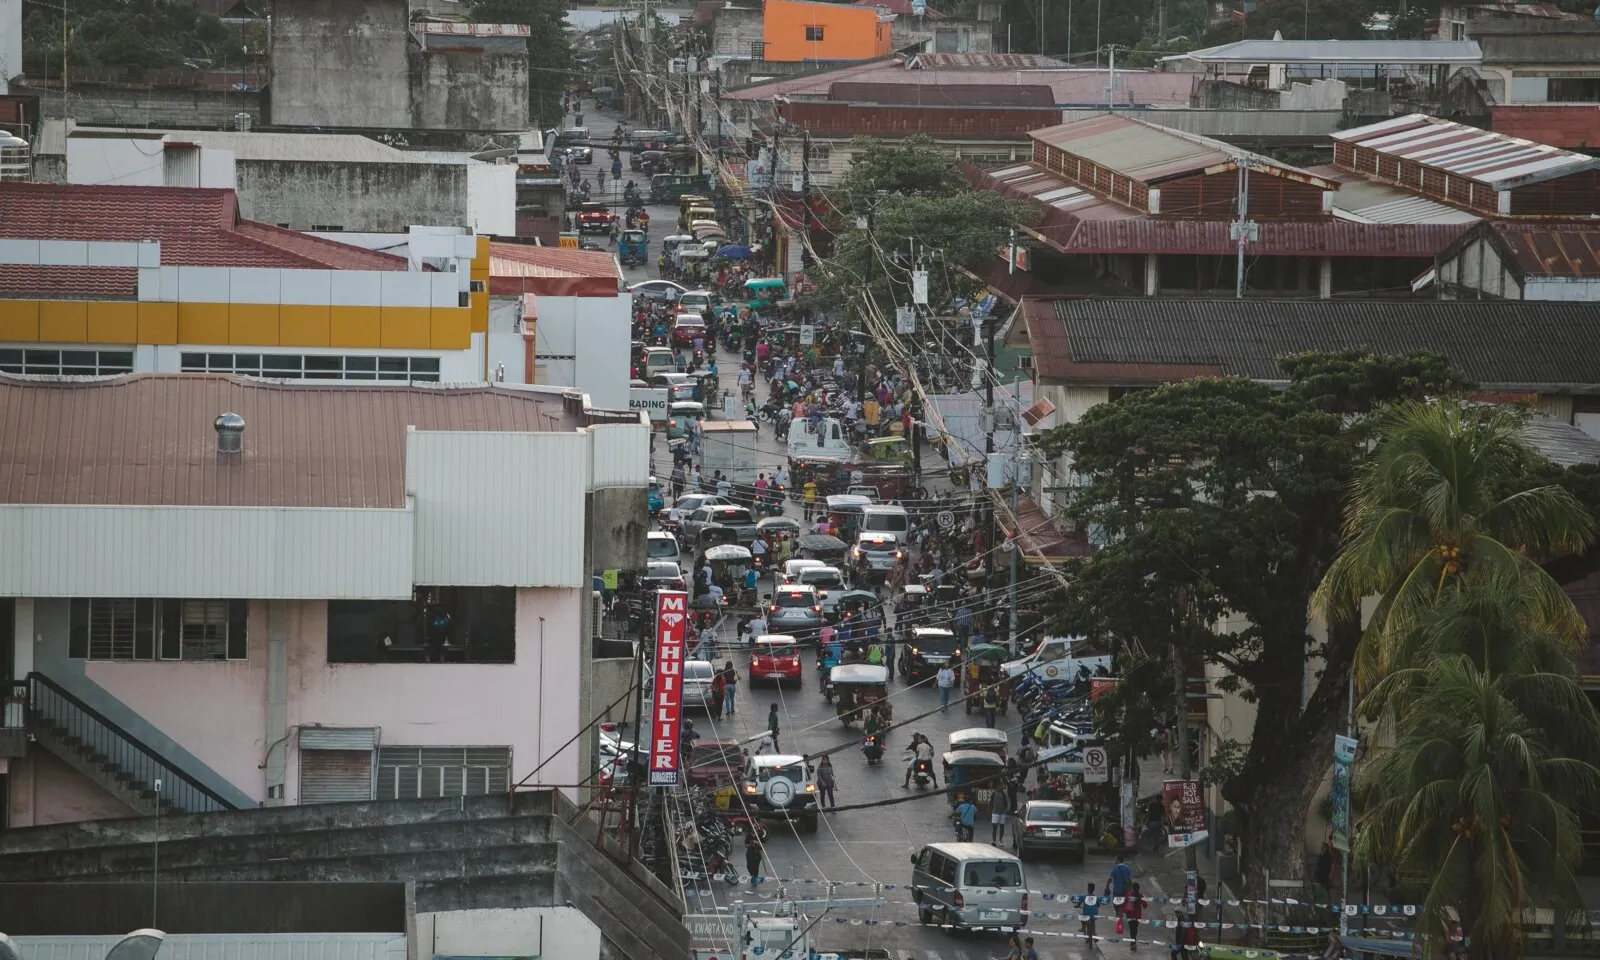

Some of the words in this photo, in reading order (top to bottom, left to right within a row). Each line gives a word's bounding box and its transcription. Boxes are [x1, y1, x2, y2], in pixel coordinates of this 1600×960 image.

[560, 239, 577, 248] WAN
[628, 400, 665, 409] RADING
[656, 630, 680, 768] LHUILLIER
[652, 772, 673, 783] DUMAGUETE
[1182, 796, 1201, 804] SALE
